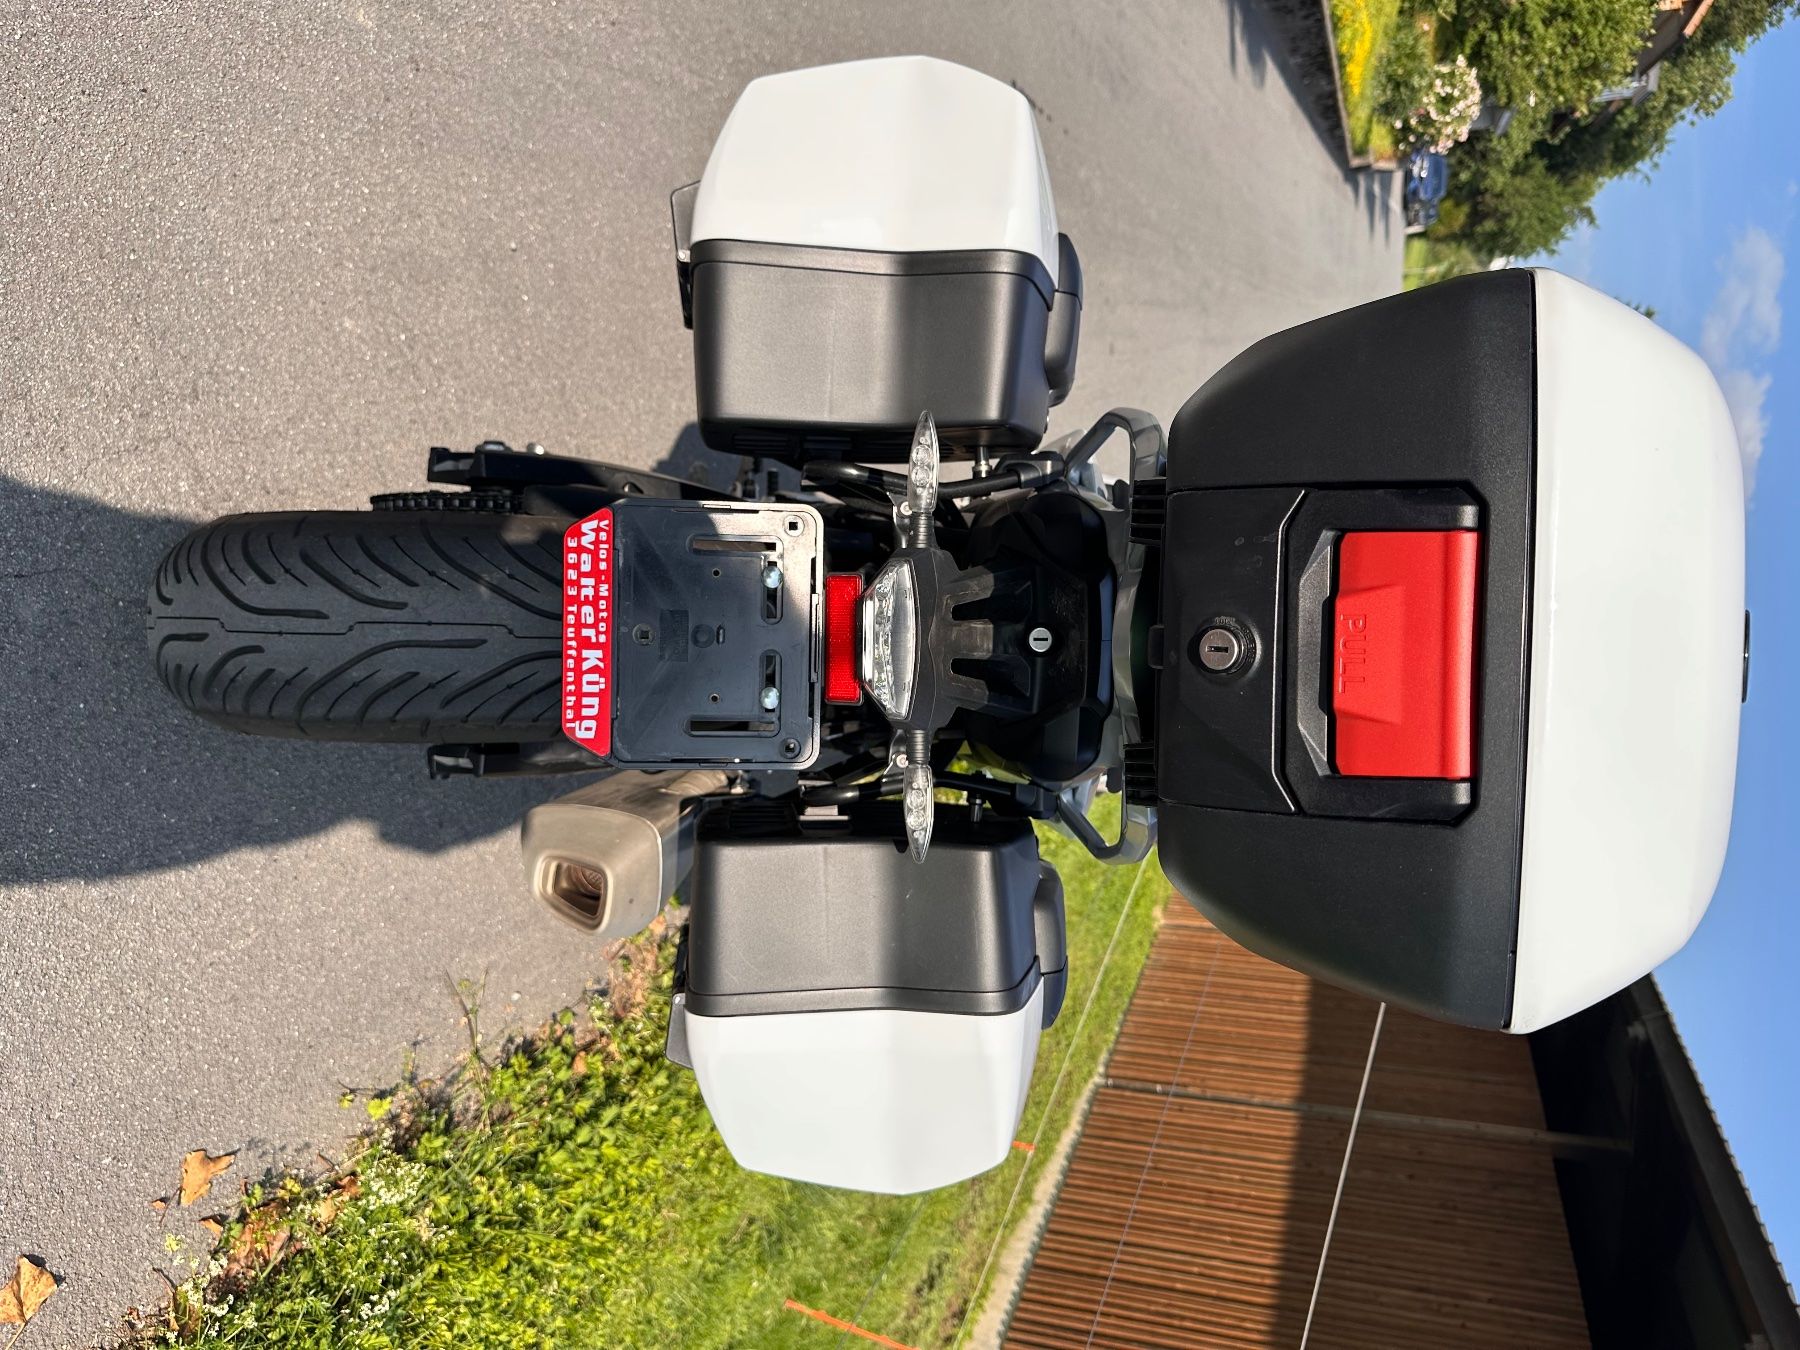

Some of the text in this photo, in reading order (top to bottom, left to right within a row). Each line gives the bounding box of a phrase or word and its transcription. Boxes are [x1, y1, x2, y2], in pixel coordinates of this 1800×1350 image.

[565, 537, 578, 728] 3623 Teuffenthal
[575, 519, 605, 739] Walter Küng
[1339, 614, 1367, 694] PULL
